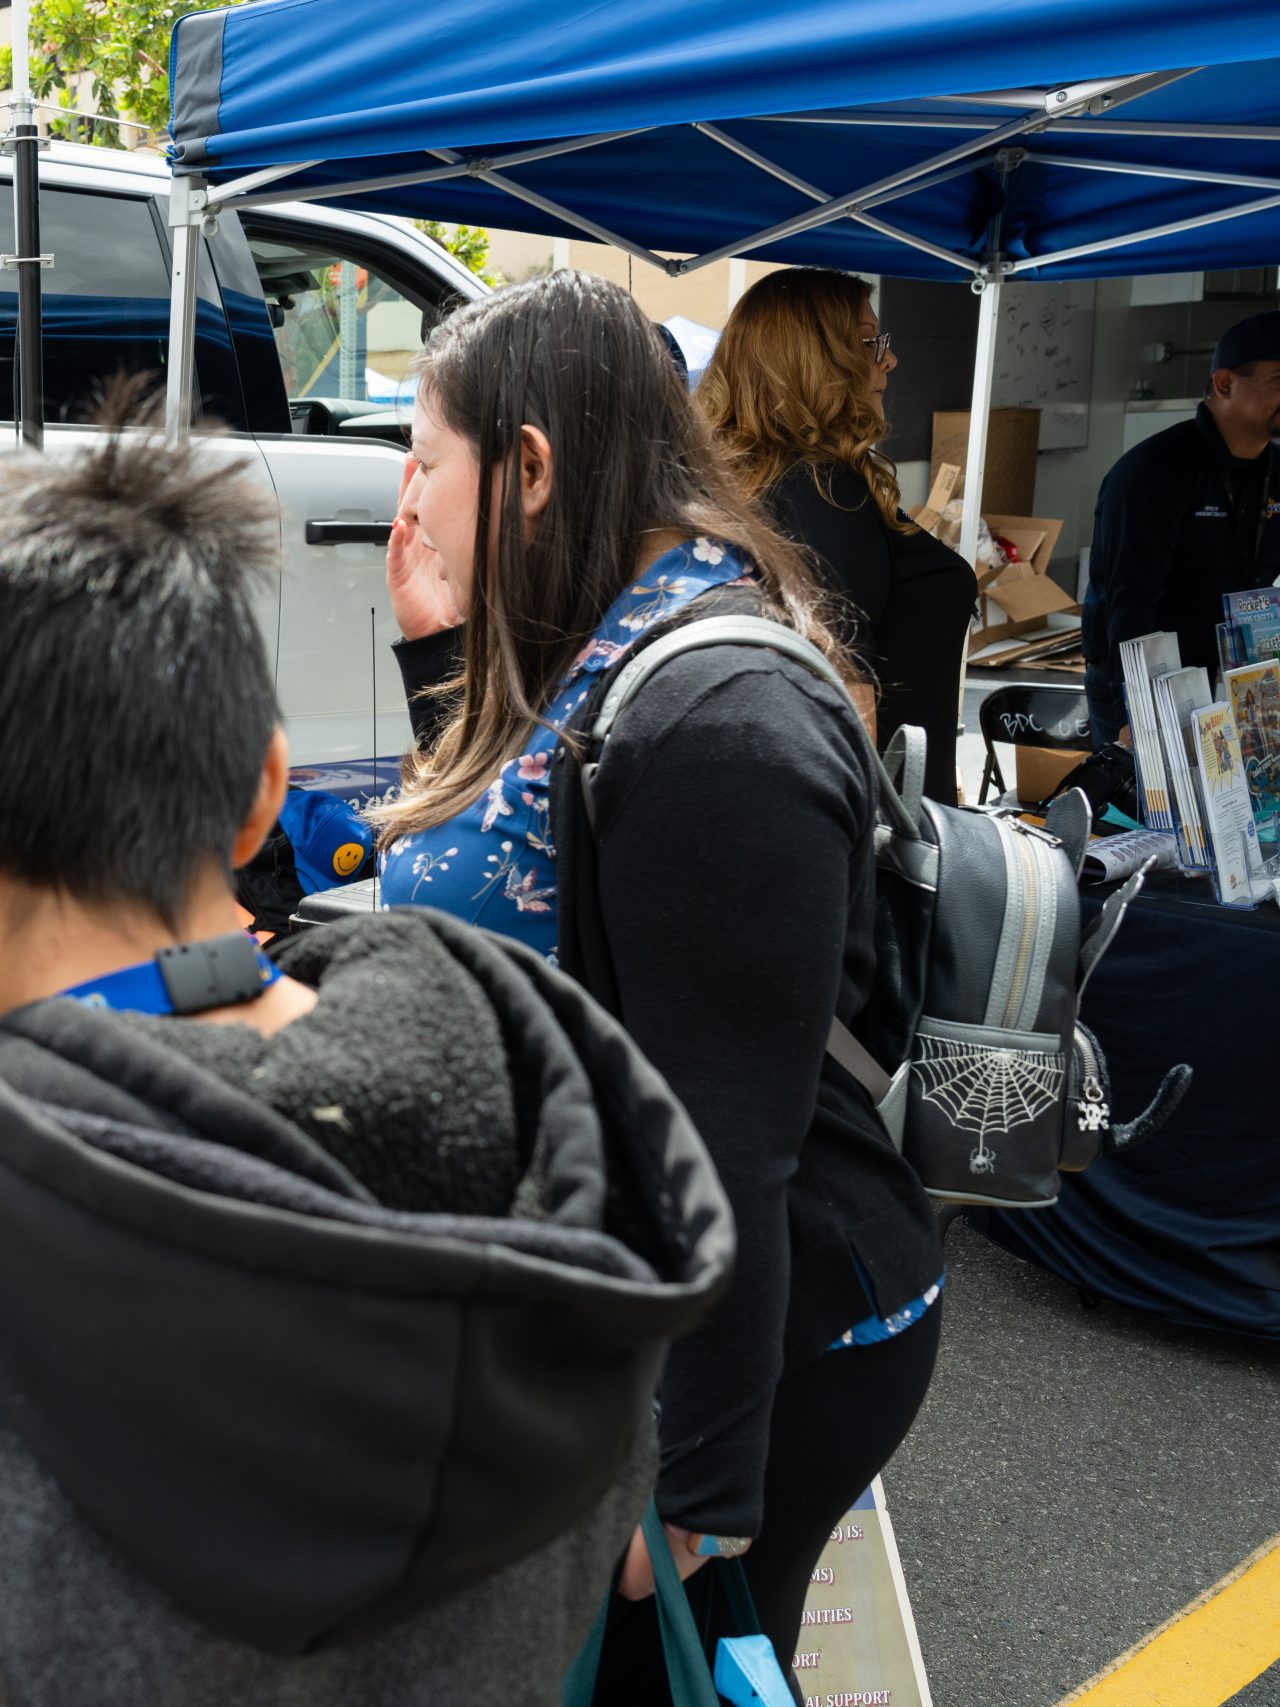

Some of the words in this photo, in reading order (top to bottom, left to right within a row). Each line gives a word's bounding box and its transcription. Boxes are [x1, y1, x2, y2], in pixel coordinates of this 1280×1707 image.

[1238, 596, 1270, 612] Rocket's
[847, 1525, 863, 1539] IS:
[826, 1690, 890, 1707] SUPPORT
